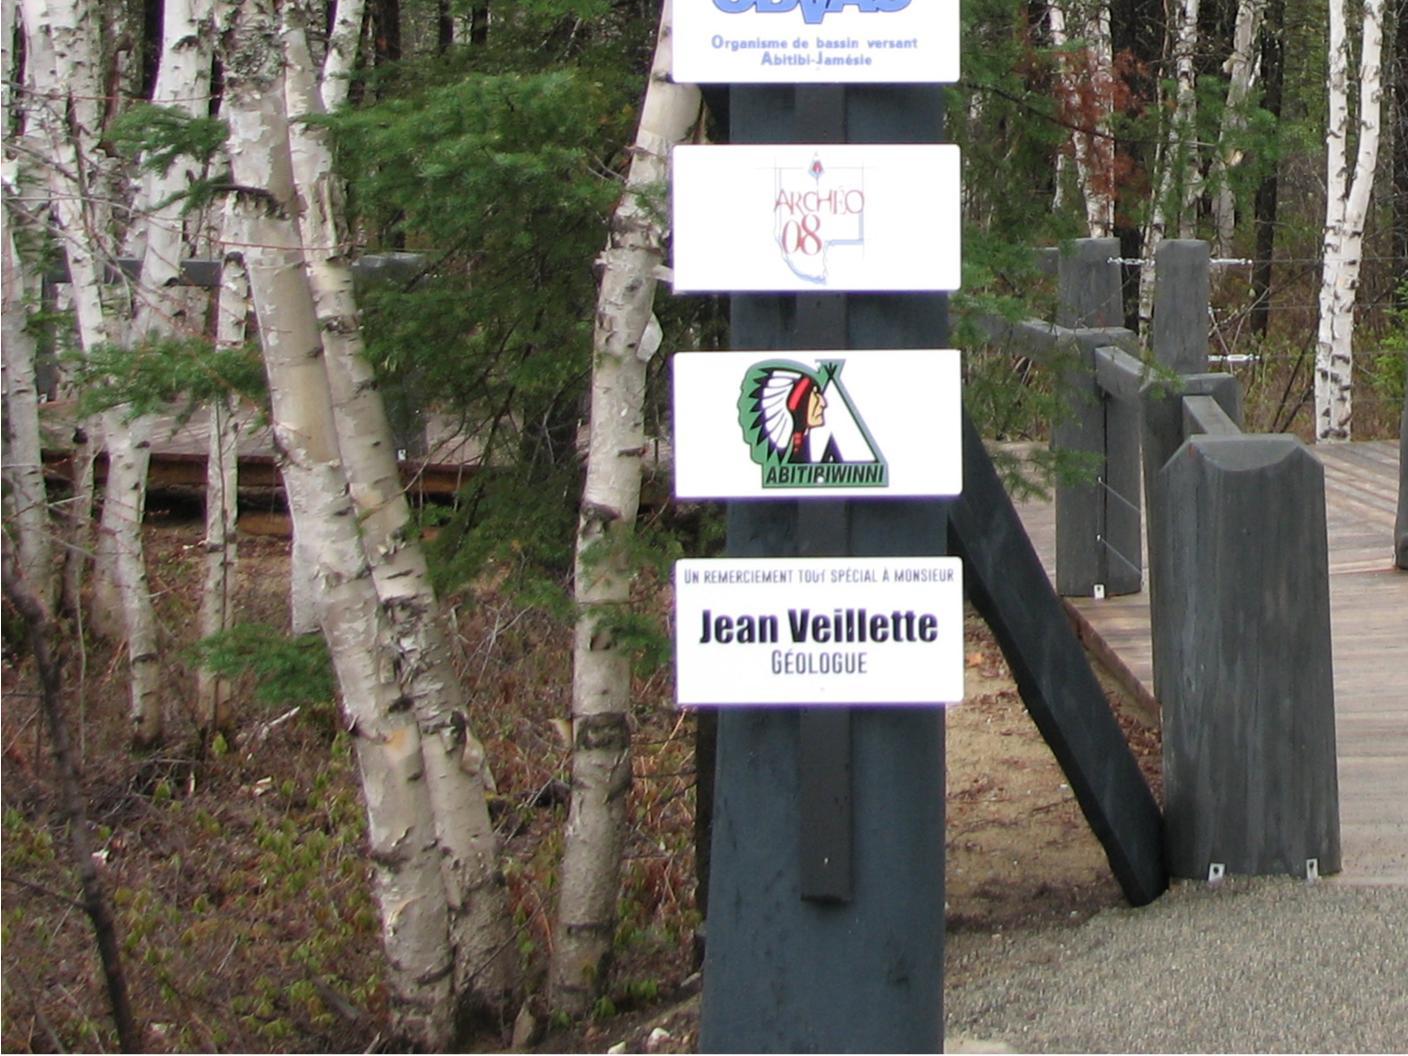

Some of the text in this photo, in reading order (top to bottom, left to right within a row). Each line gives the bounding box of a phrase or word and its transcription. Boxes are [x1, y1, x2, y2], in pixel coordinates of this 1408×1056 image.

[711, 34, 918, 51] Organisme de bassin versant
[781, 214, 822, 256] 08
[704, 568, 793, 584] REMERCIEMENT
[830, 566, 877, 583] SPÉCIAL
[882, 566, 889, 582] À
[894, 568, 954, 583] MONSIEUR
[699, 607, 939, 644] Jean Veillette
[771, 646, 867, 675] GÉOLOGUE
